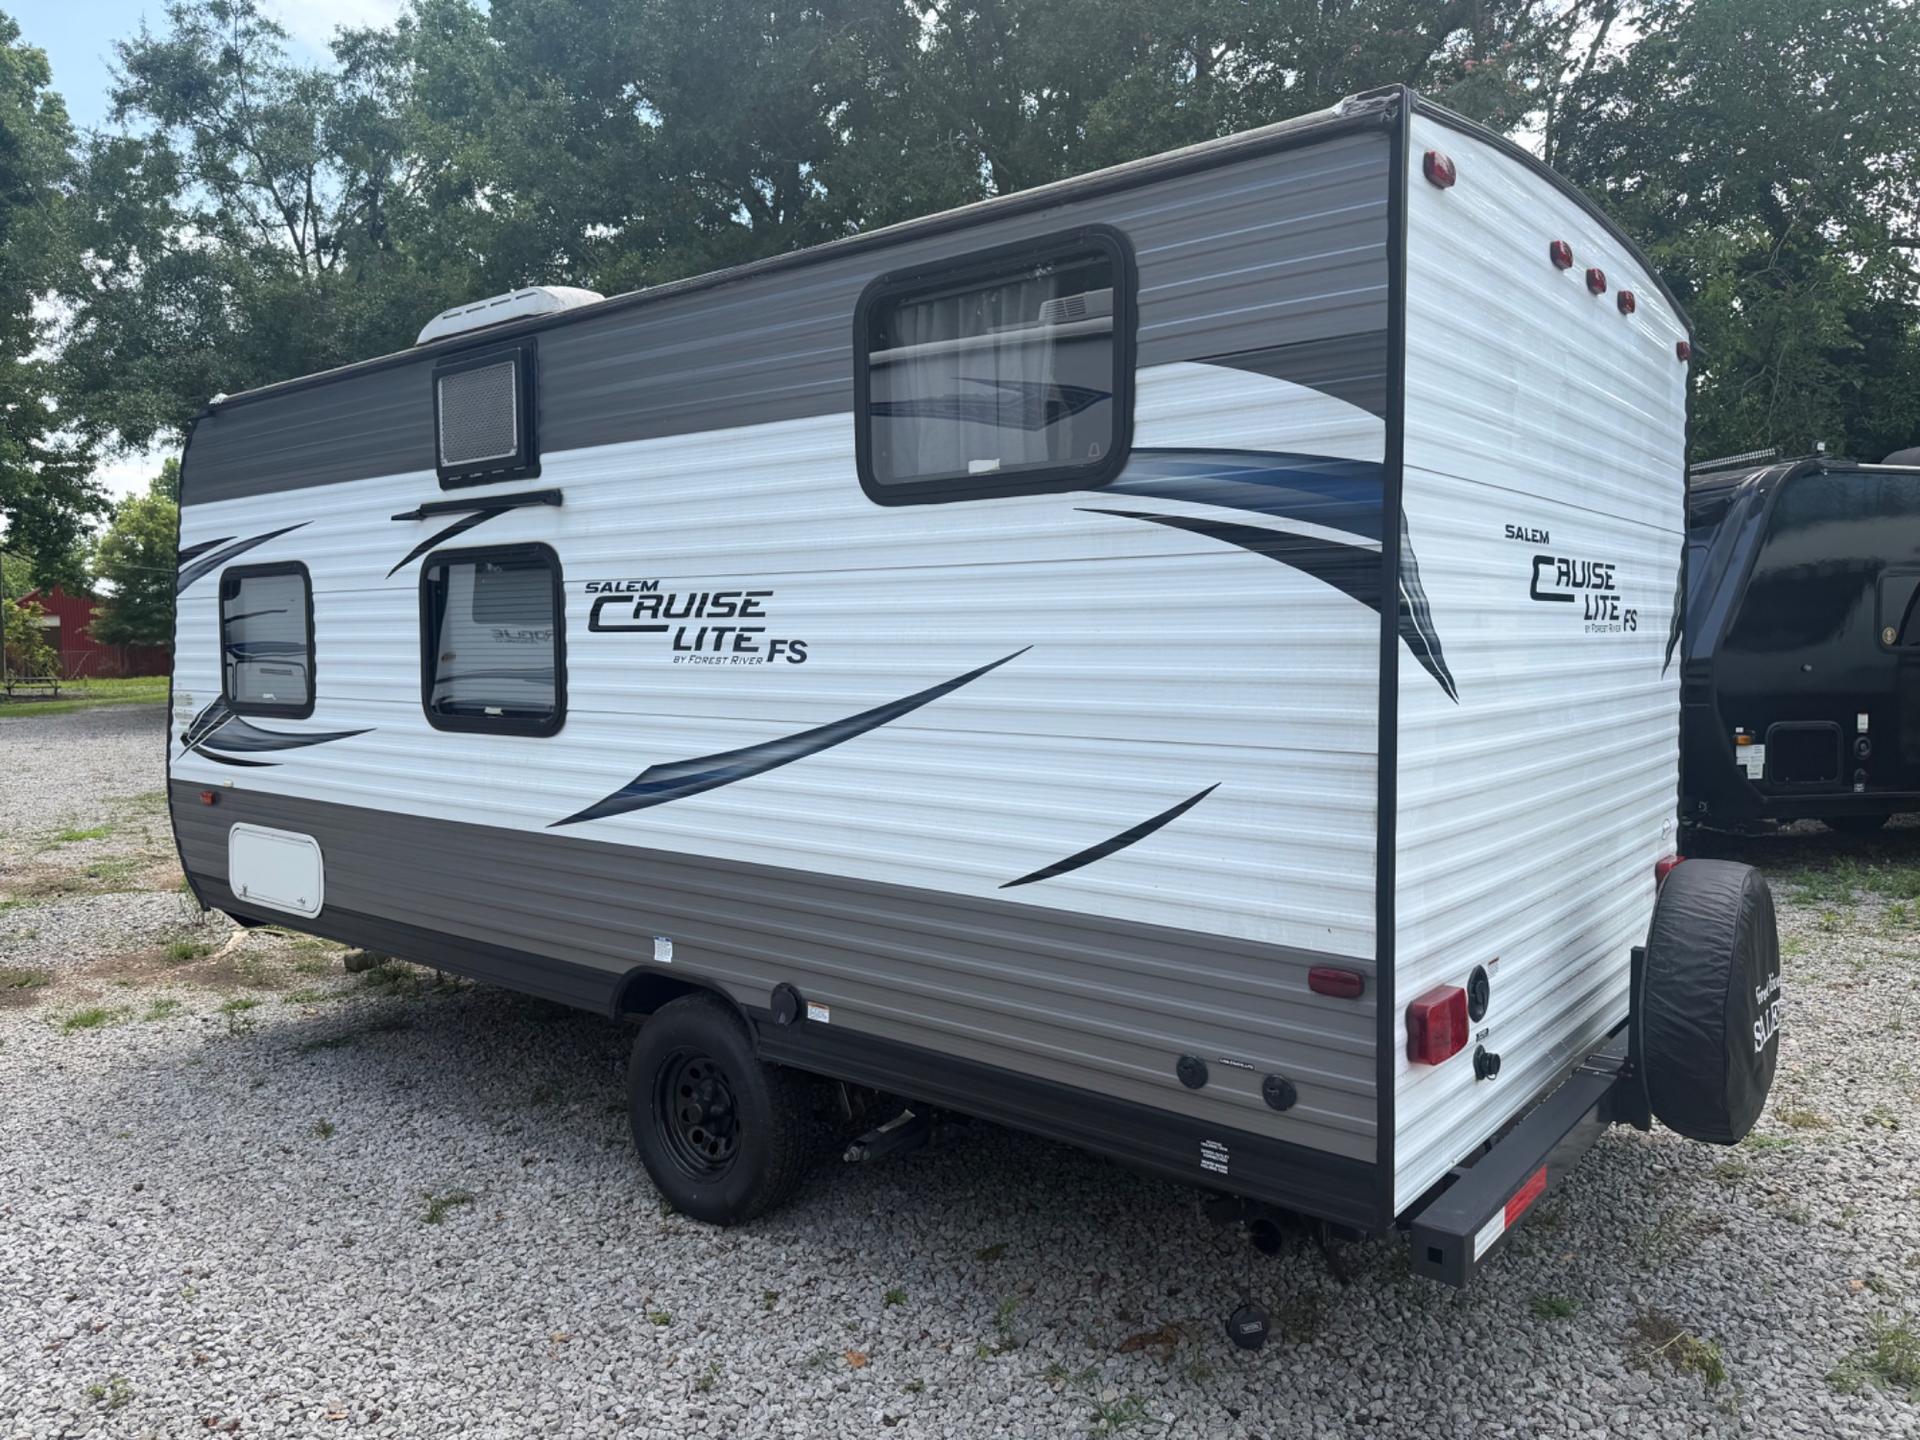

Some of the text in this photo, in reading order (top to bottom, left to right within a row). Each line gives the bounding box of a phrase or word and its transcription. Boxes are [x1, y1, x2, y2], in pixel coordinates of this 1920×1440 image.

[1505, 524, 1550, 545] SALEM
[585, 580, 660, 594] SALEM
[1530, 555, 1616, 603] CRUISE
[588, 591, 774, 632] CRUISE
[1584, 594, 1638, 632] LITE FS
[673, 626, 808, 664] LITE FS
[673, 655, 764, 665] BY FOREST RIVER
